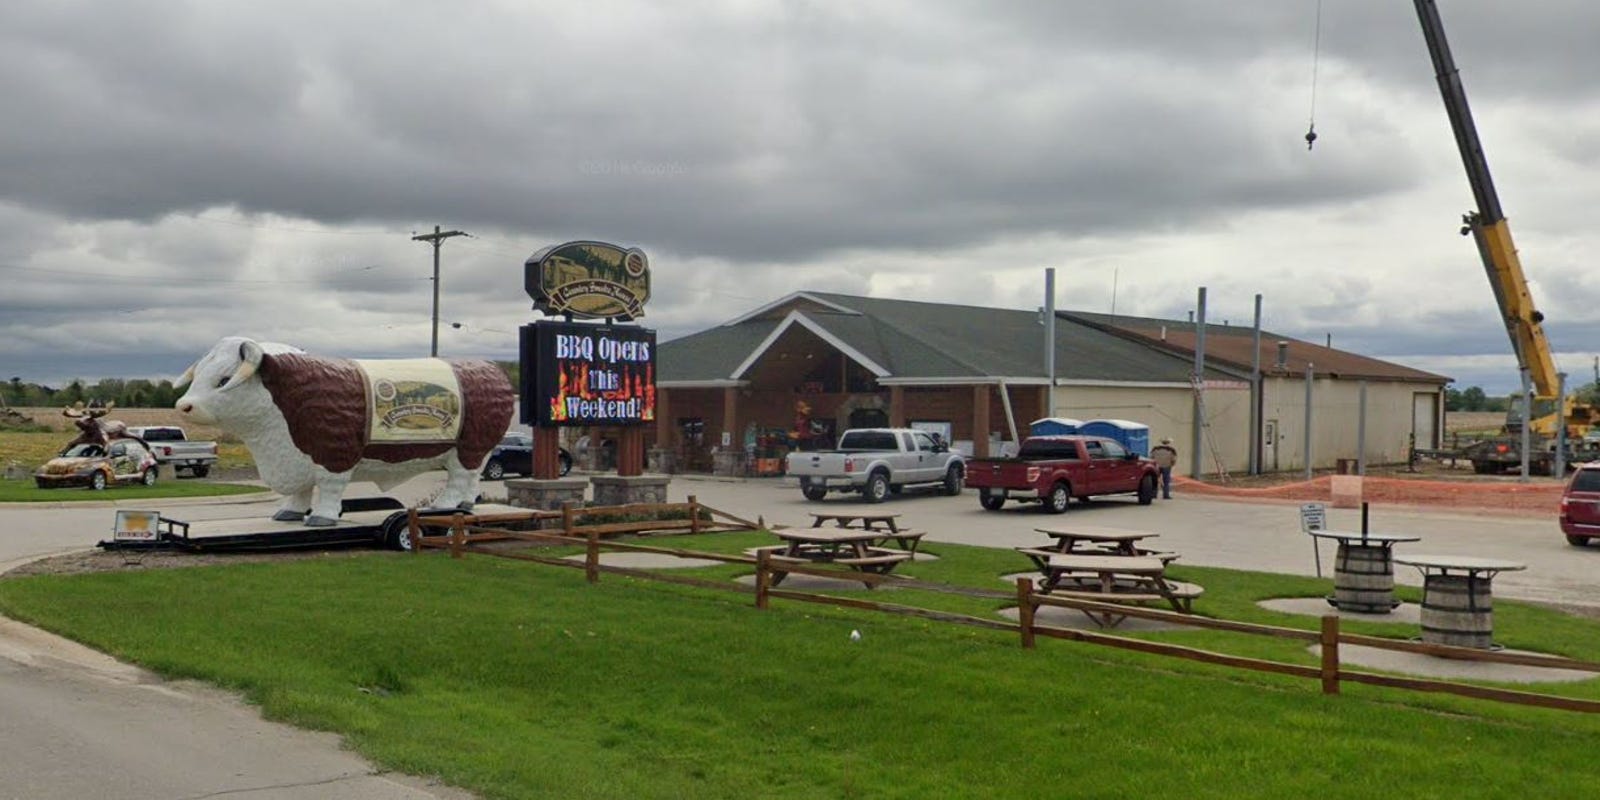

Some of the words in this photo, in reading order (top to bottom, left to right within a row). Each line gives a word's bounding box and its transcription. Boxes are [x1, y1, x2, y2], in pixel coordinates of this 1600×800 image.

[556, 334, 593, 362] BBQ
[598, 336, 650, 363] Opens
[589, 369, 619, 390] This
[566, 396, 642, 418] Weekend!
